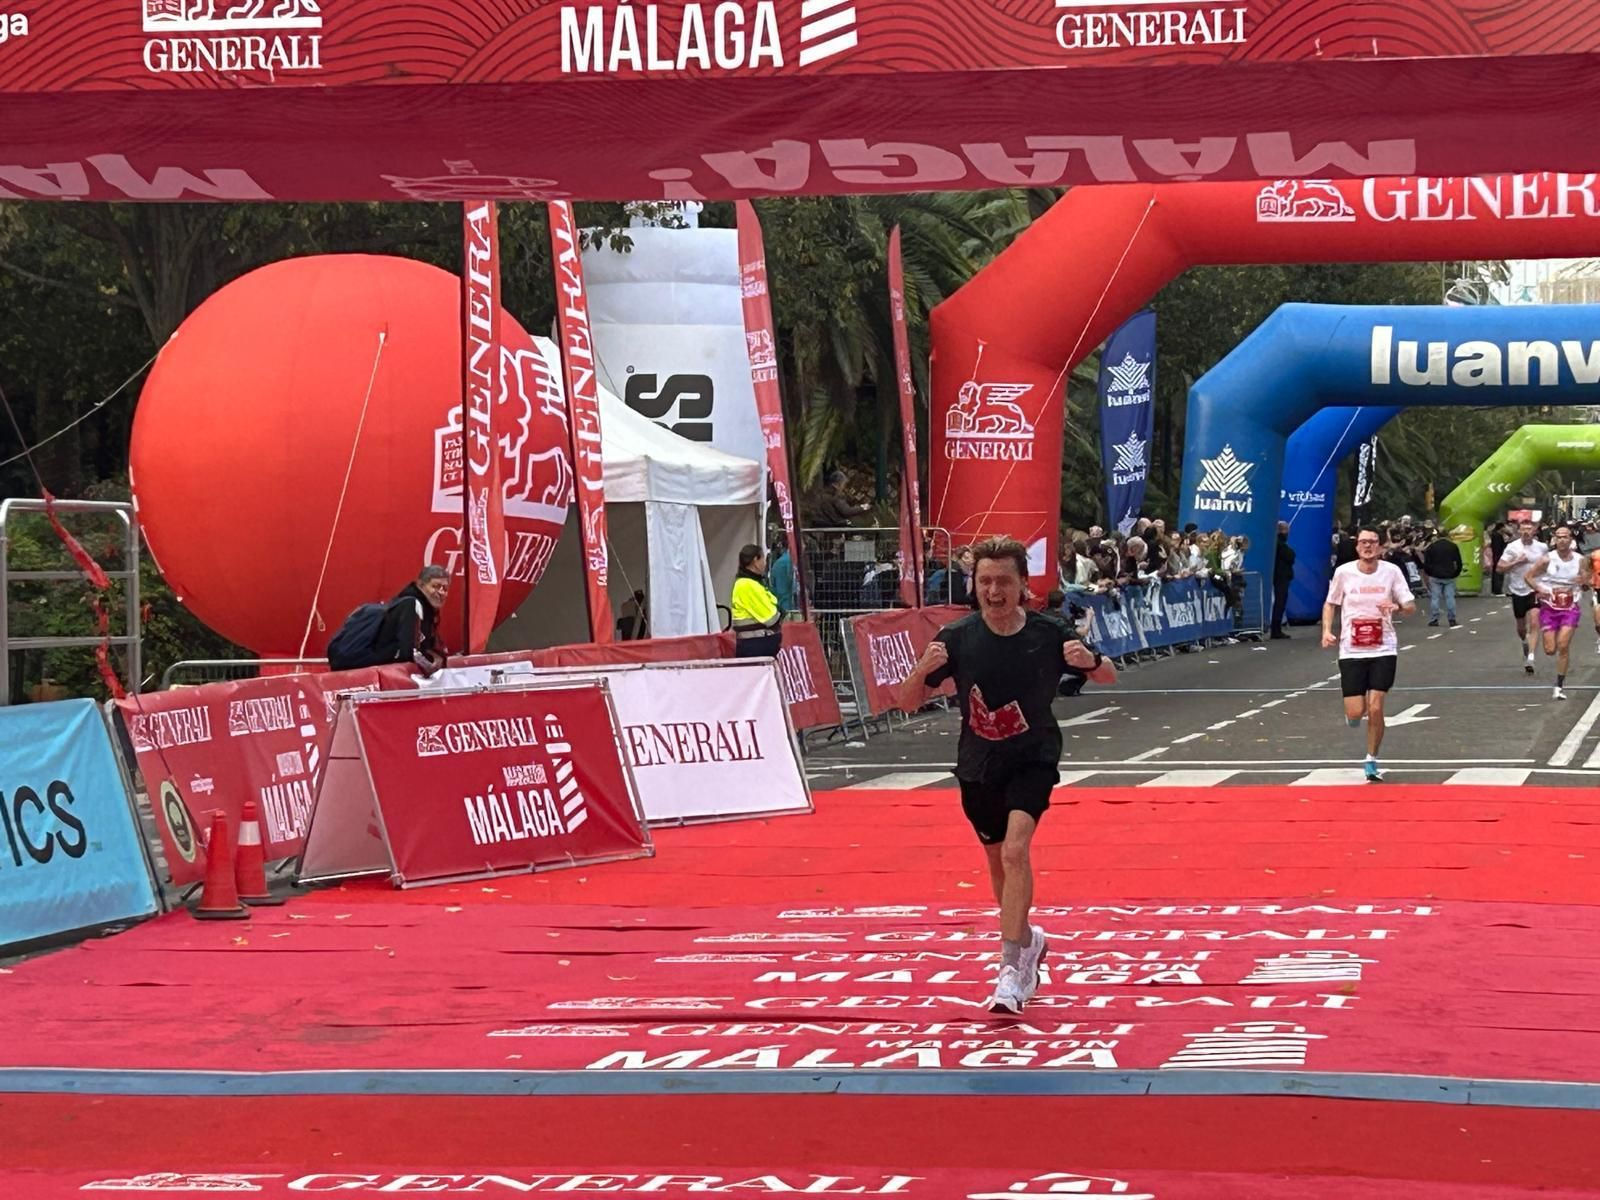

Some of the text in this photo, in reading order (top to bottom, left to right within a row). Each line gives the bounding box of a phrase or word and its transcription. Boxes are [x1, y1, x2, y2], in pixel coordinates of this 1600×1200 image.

[1056, 7, 1248, 49] GENERALI
[142, 34, 323, 73] GENERALI
[944, 440, 1034, 461] GENERALI
[1194, 493, 1253, 514] luanvi
[444, 716, 539, 755] GENERALI
[623, 719, 765, 768] ENERALI
[464, 784, 566, 845] MÁLAGA
[647, 1022, 1145, 1037] GENERALI
[584, 1043, 1119, 1069] MÁLAGA
[287, 1173, 929, 1194] GENERALI
